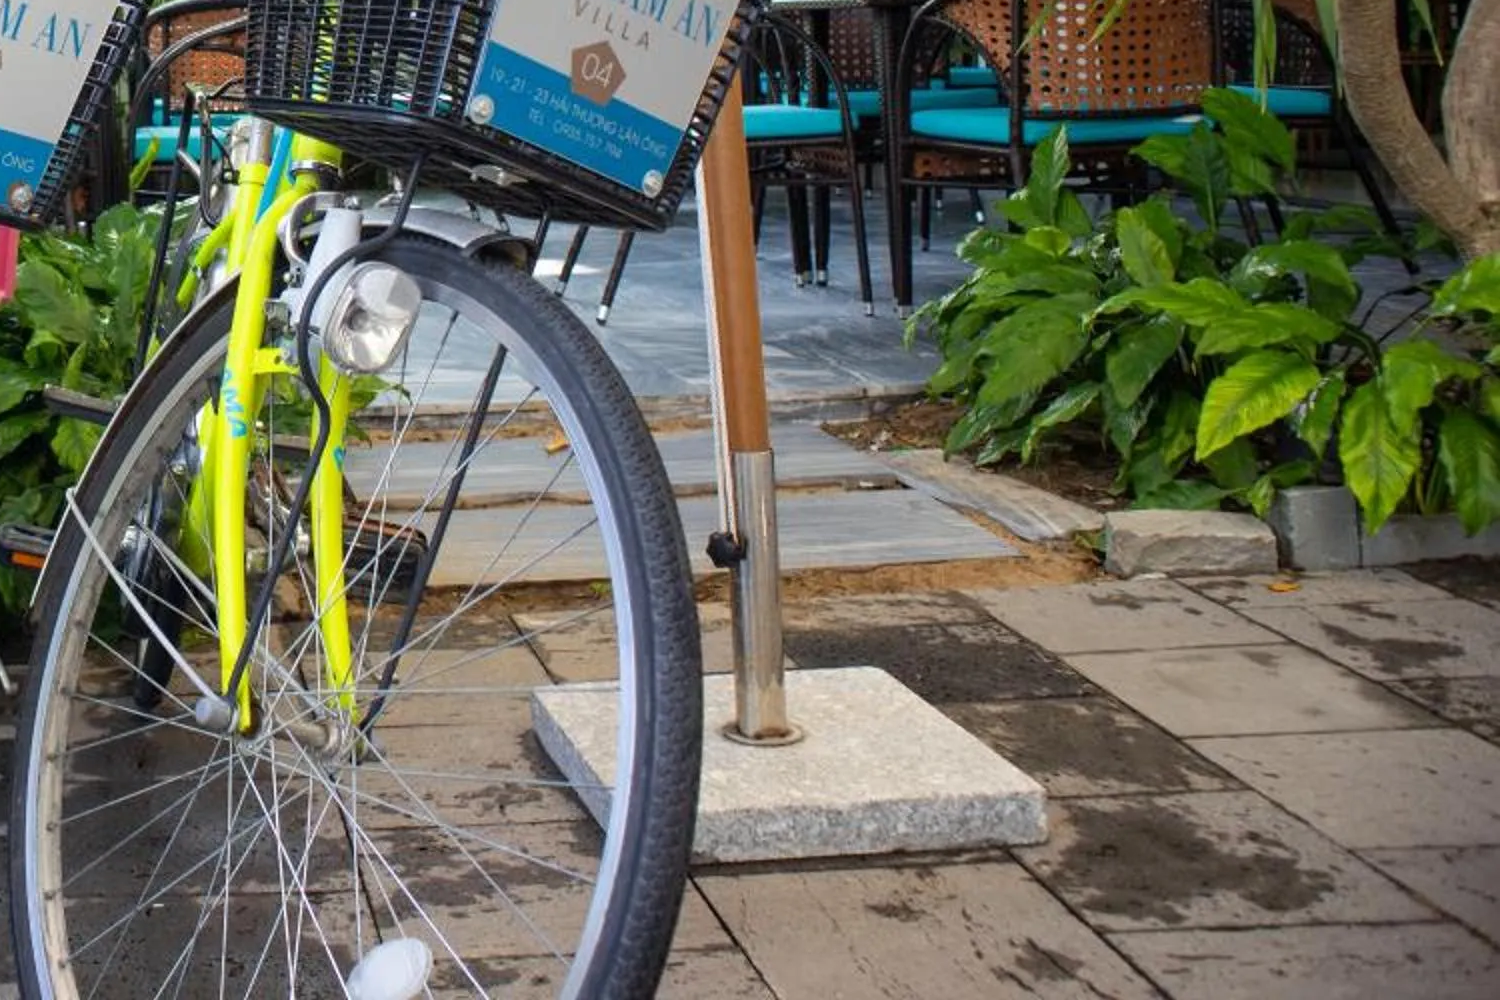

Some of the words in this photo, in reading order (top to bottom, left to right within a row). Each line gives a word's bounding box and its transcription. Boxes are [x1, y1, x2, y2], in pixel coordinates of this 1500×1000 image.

[31, 12, 92, 58] AN
[673, 1, 723, 48] AN
[490, 67, 506, 84] 19
[510, 77, 527, 94] 21
[581, 53, 613, 88] 04
